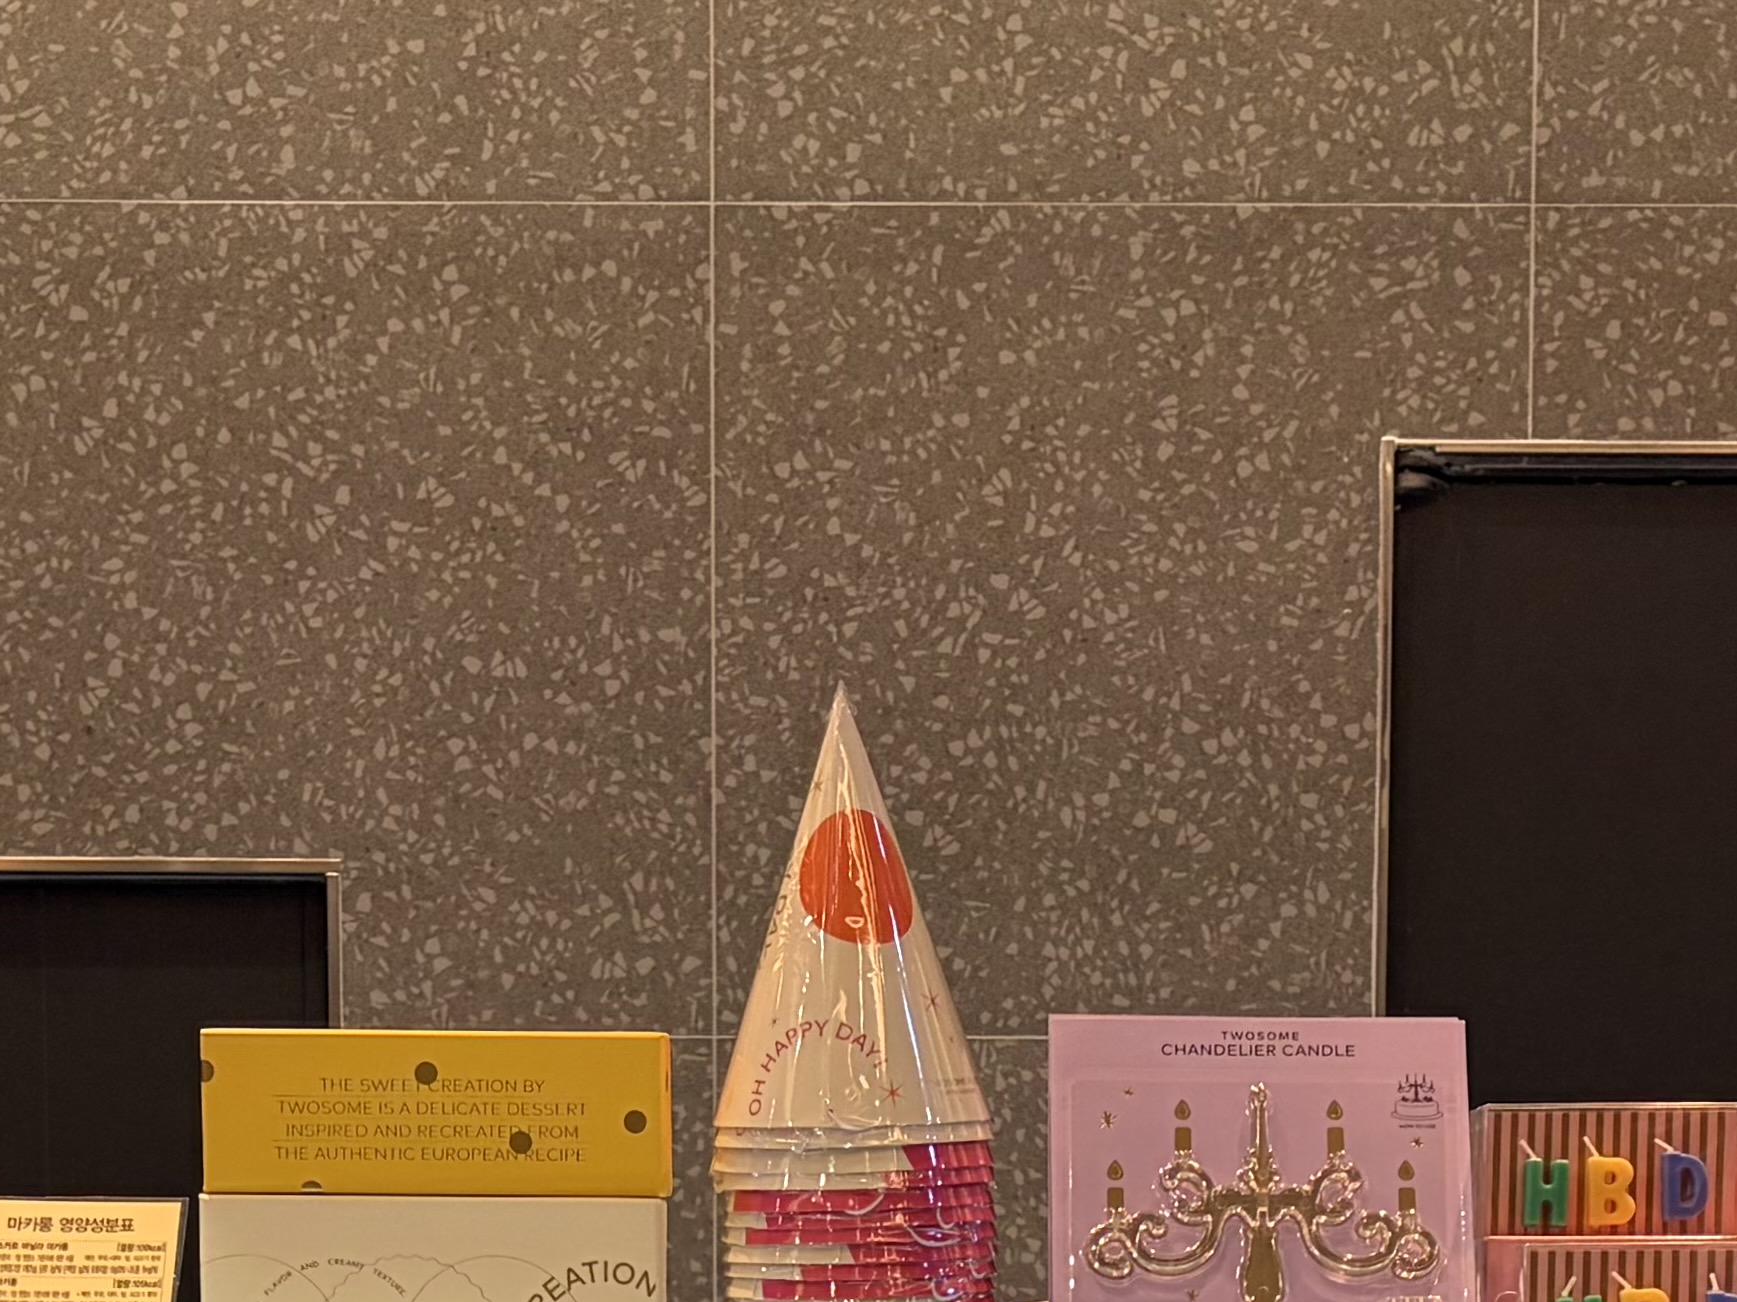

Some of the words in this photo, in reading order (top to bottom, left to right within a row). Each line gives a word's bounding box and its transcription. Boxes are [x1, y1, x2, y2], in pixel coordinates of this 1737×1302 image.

[1221, 1031, 1300, 1041] TWOSOME
[1161, 1043, 1276, 1057] CHANDELIER
[1282, 1044, 1356, 1057] CANDLE
[749, 1079, 766, 1116] OH
[761, 1019, 829, 1073] HAPPY
[320, 1077, 353, 1093] THE
[427, 1078, 517, 1093] CREATION
[523, 1079, 545, 1093] BY
[278, 1100, 372, 1116] TWOSOME
[378, 1101, 395, 1115] IS
[399, 1101, 411, 1115] A
[416, 1101, 500, 1116] DELICATE
[507, 1102, 586, 1117] DESSERT
[285, 1123, 368, 1138] INSPIRED
[373, 1124, 411, 1139] AND
[417, 1124, 521, 1139] RECREATED
[526, 1125, 579, 1140] FROM
[275, 1146, 306, 1161] THE
[314, 1147, 416, 1161] AUTHENTIC
[421, 1147, 517, 1162] EUROPEAN
[524, 1148, 586, 1163] RECIPE
[7, 1216, 53, 1232] 마카롱
[59, 1217, 135, 1233] 영양성분표
